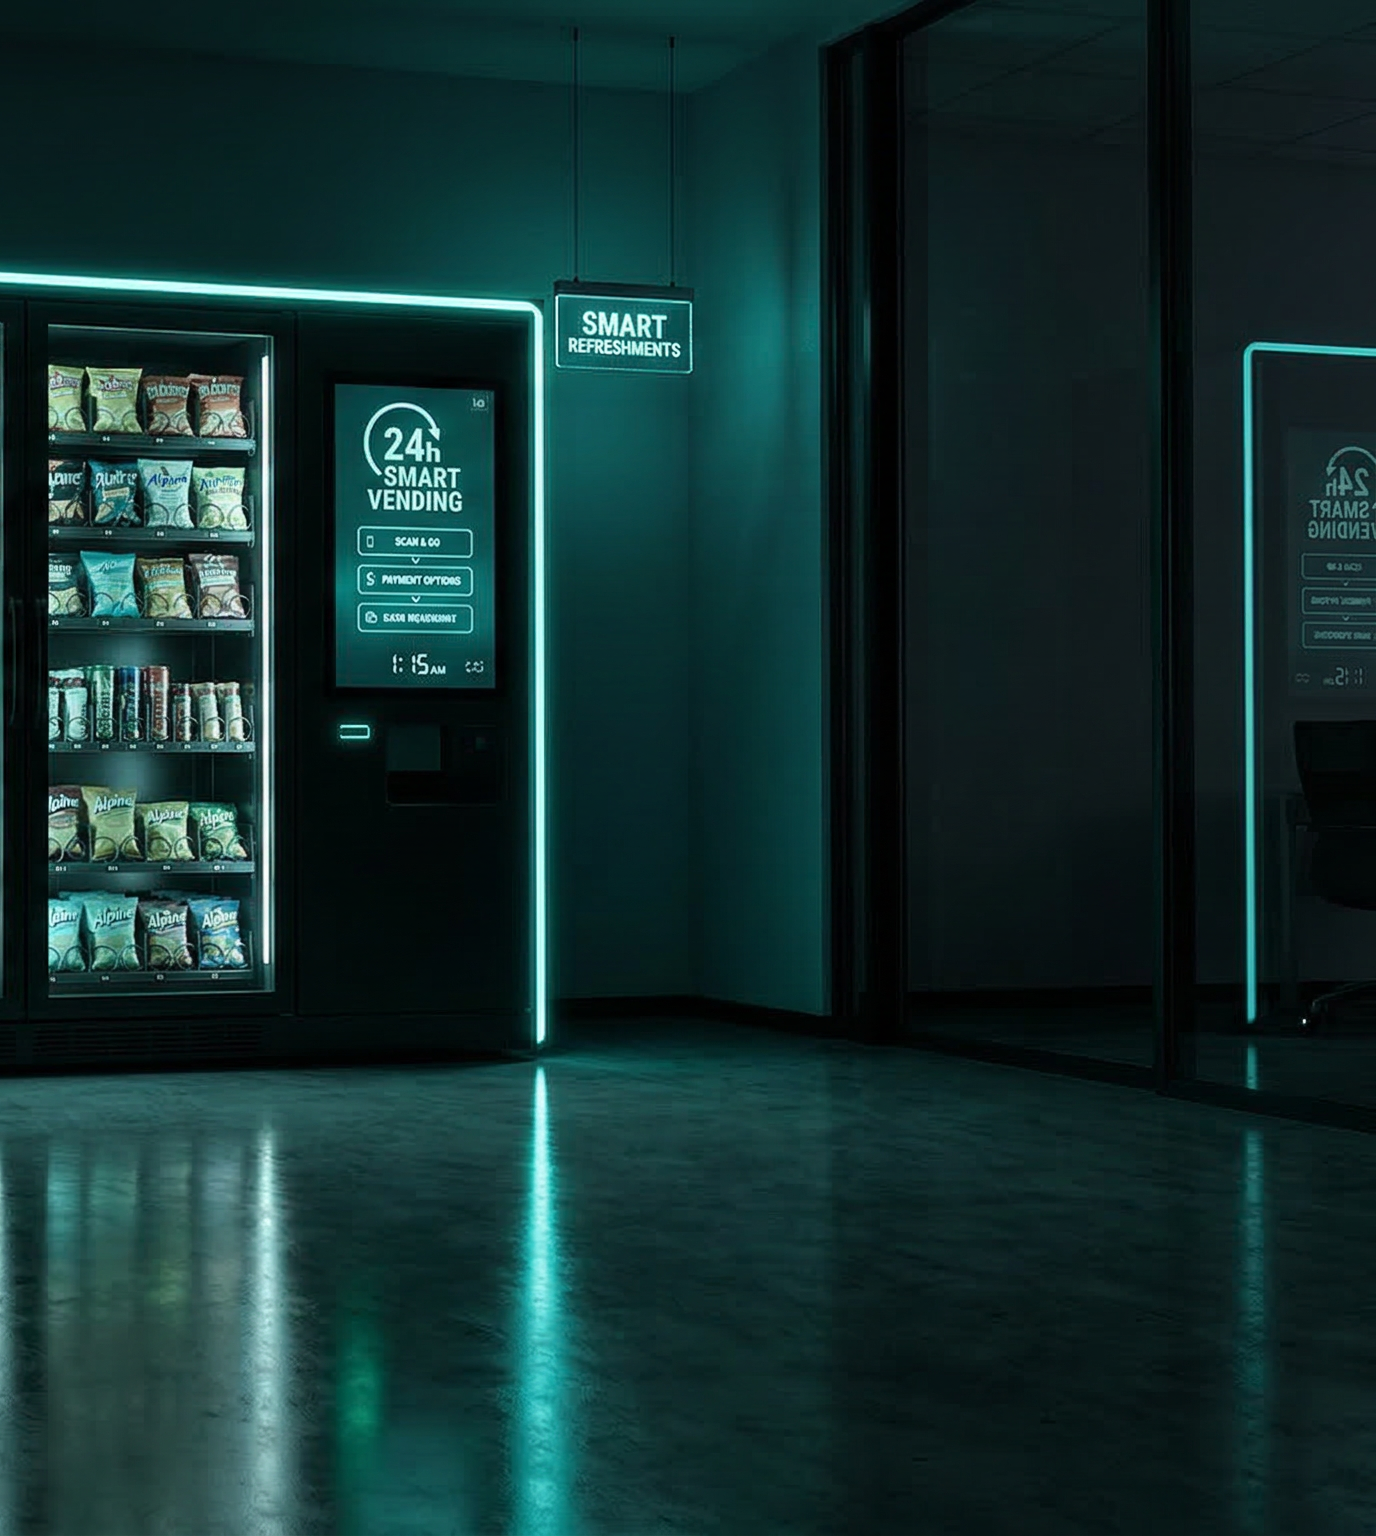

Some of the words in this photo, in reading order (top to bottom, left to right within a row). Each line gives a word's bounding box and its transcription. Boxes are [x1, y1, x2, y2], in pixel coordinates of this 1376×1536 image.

[582, 310, 668, 340] SMART
[568, 337, 682, 358] REFRESHMENTS
[384, 426, 442, 463] 24h
[383, 465, 462, 489] SMART
[367, 488, 463, 513] VENDING
[392, 653, 429, 675] 1:15
[429, 665, 447, 675] AM
